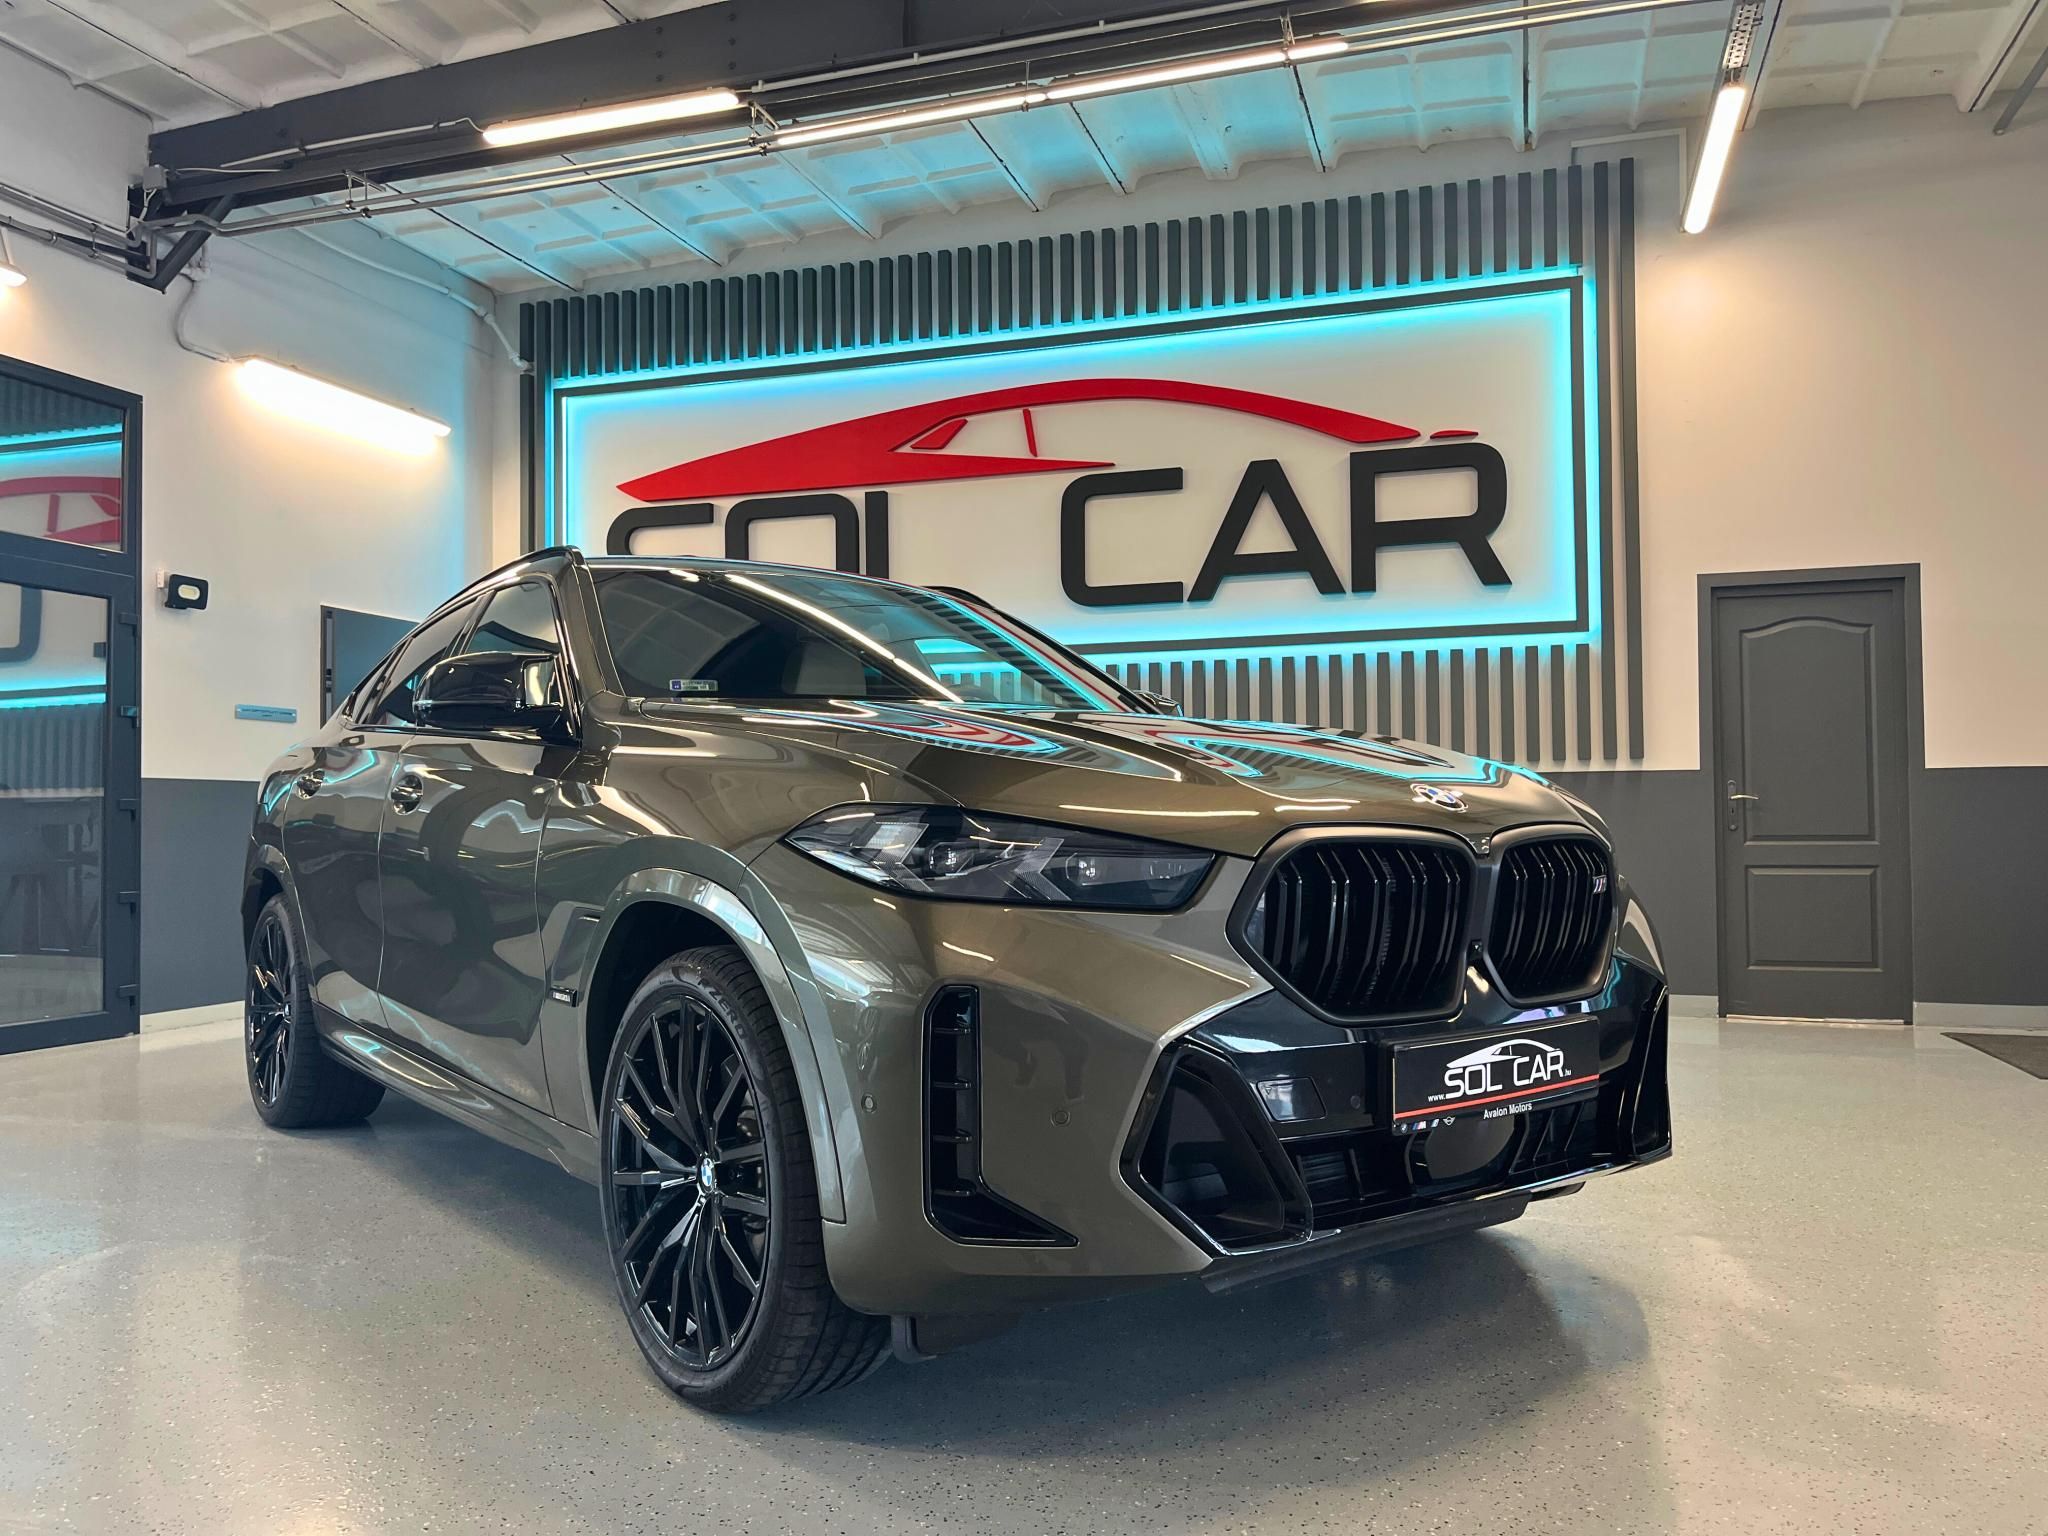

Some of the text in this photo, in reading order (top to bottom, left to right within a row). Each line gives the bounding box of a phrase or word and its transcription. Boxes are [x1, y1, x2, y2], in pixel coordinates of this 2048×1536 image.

[1060, 442, 1512, 607] CAR
[1483, 1102, 1532, 1120] Avalon Motors
